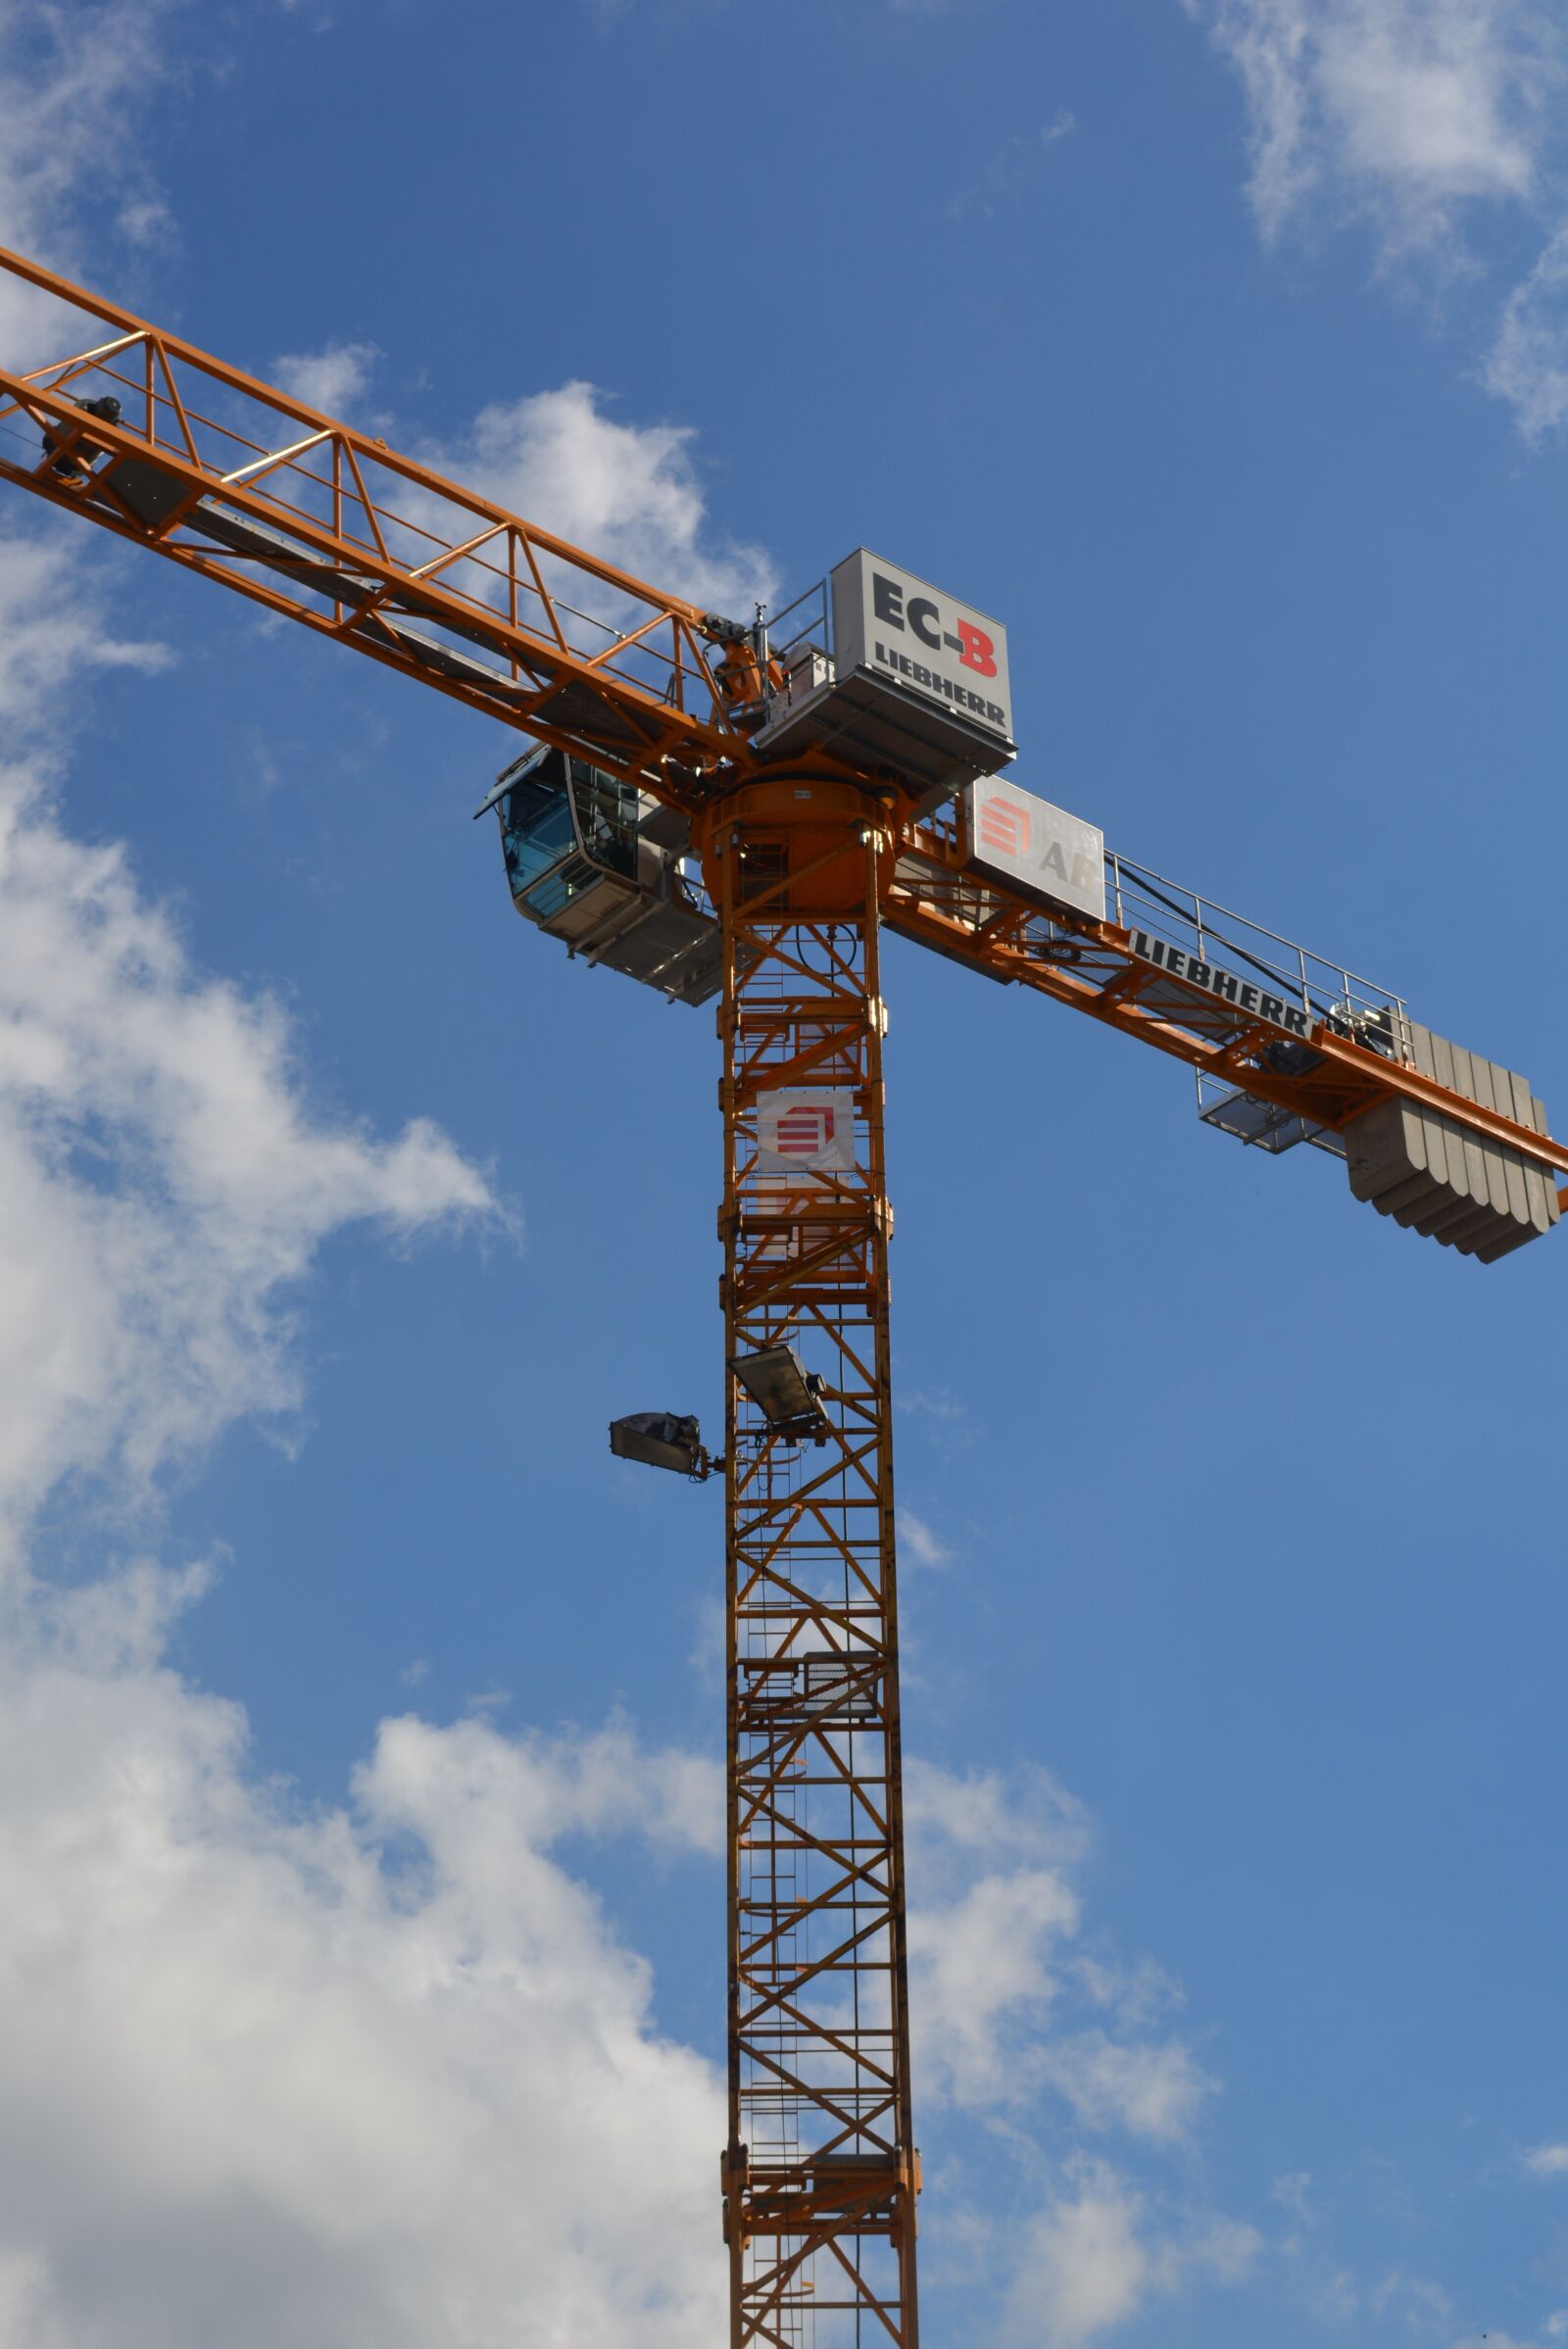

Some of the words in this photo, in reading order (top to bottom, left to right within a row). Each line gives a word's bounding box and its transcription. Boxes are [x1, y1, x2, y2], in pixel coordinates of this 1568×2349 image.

[872, 571, 998, 678] EC-B
[875, 641, 1006, 729] LIEBHERR
[1135, 931, 1308, 1039] LIEBHERR
